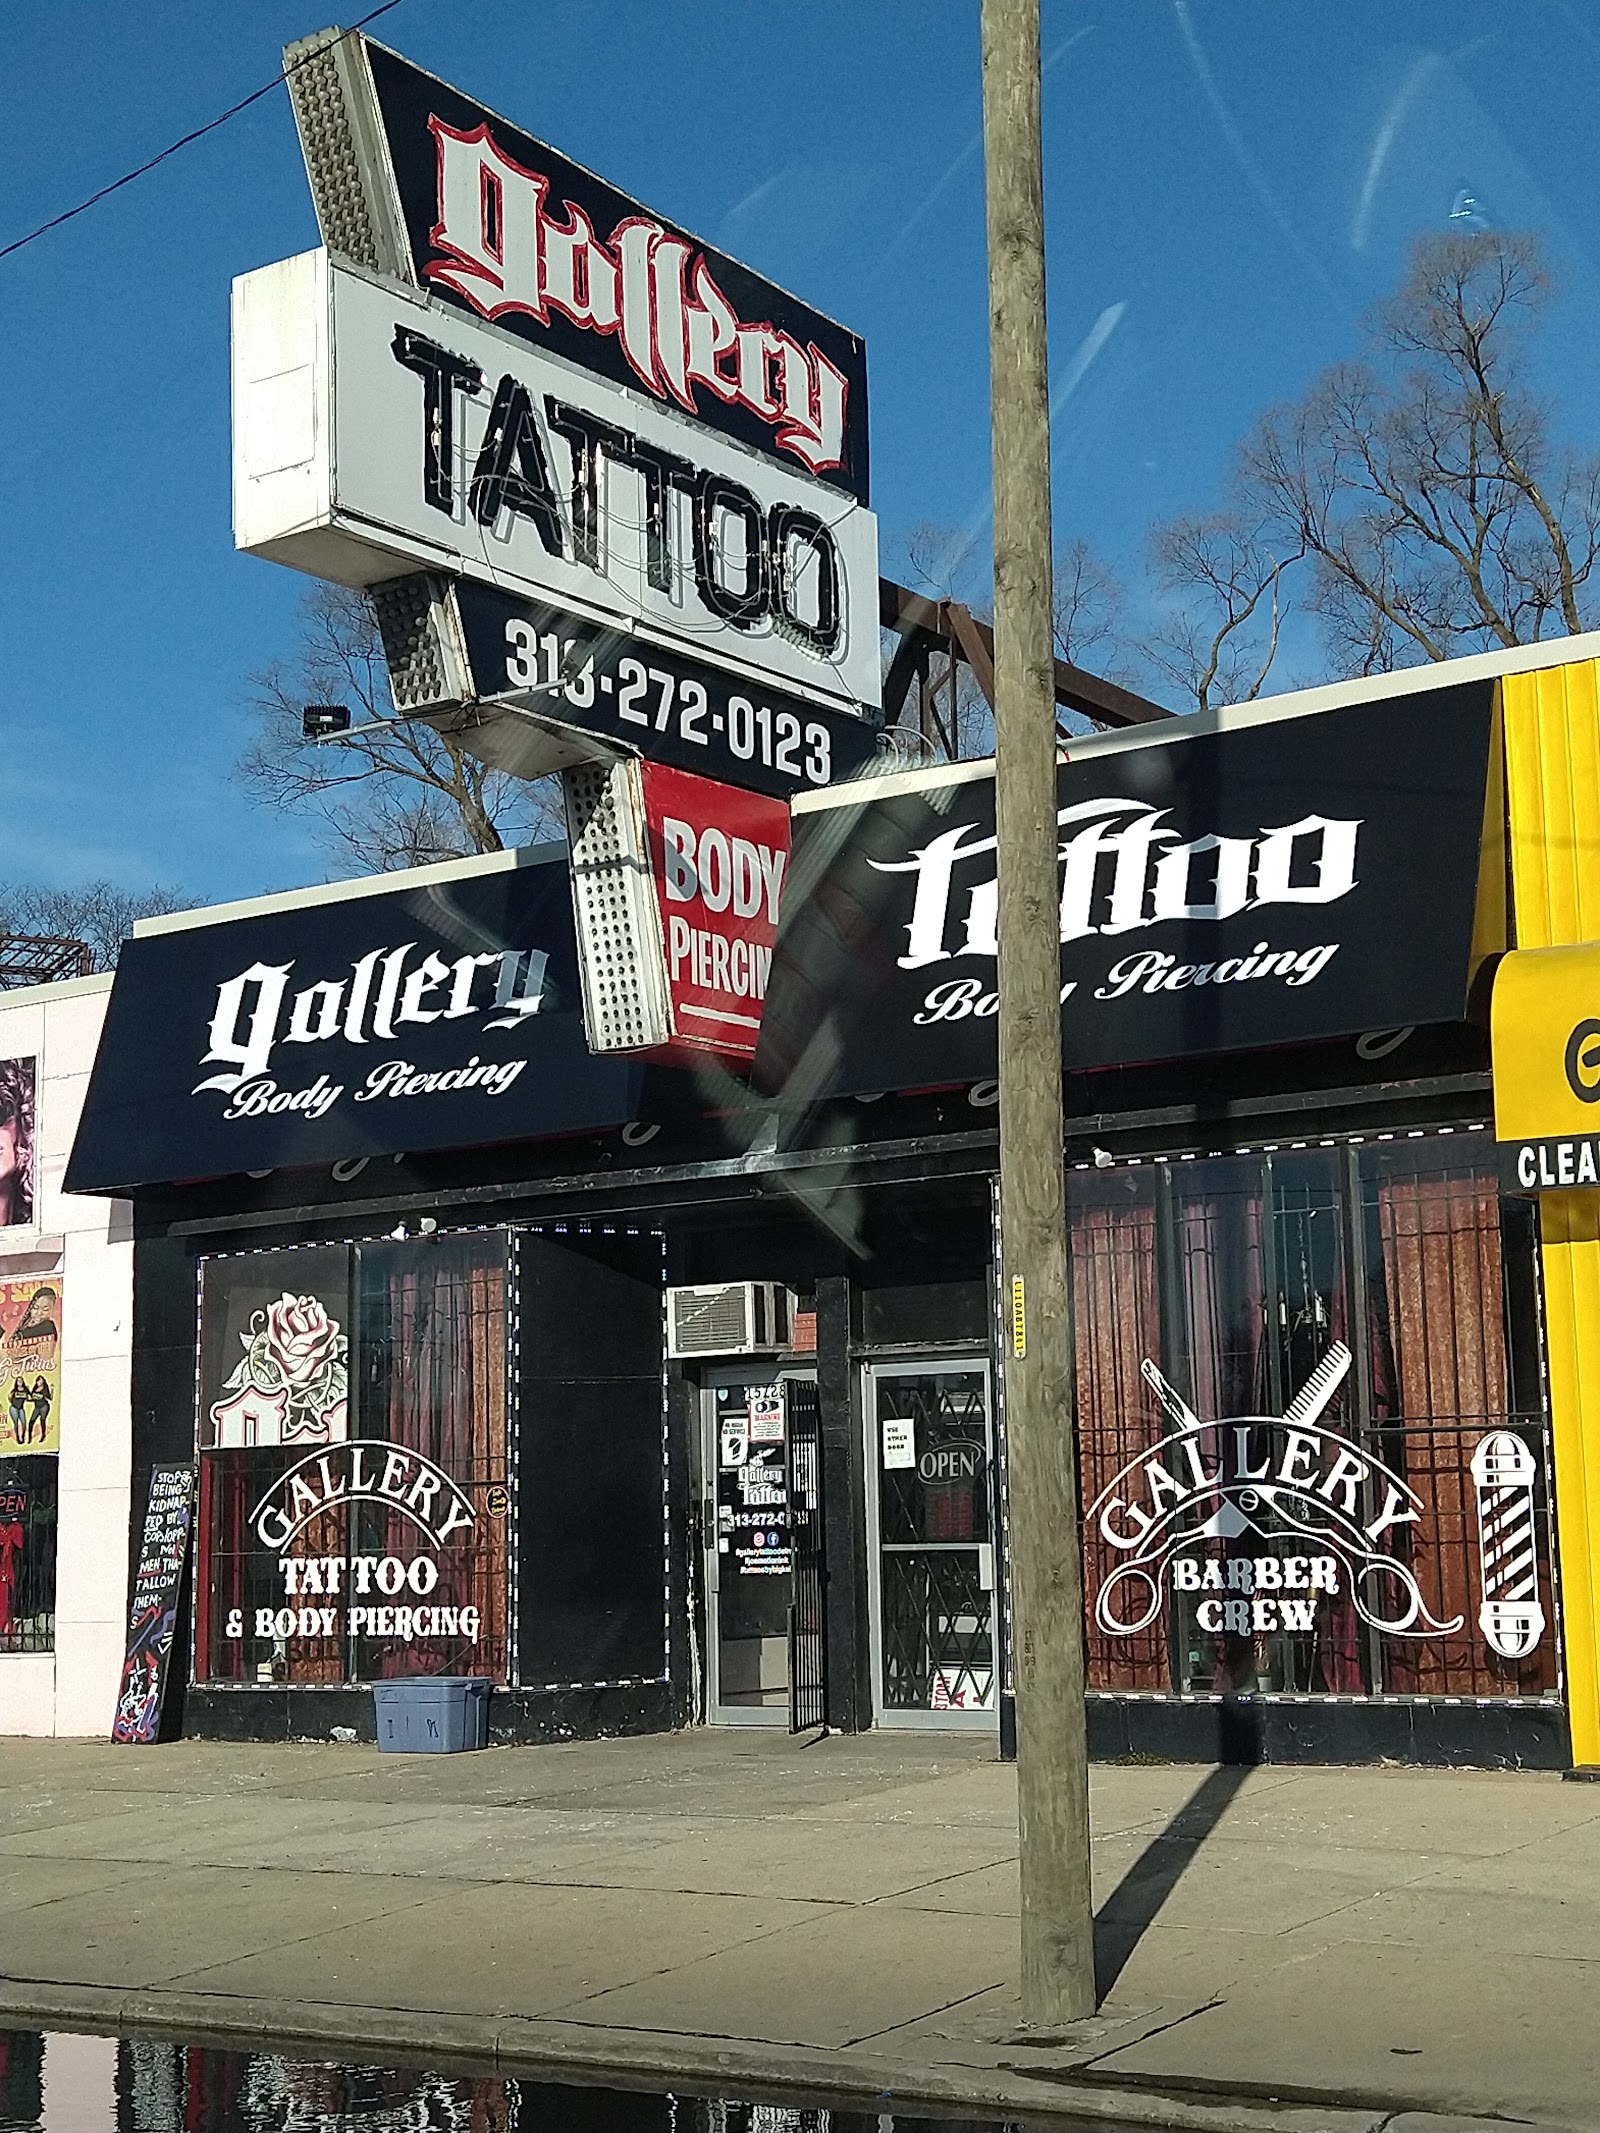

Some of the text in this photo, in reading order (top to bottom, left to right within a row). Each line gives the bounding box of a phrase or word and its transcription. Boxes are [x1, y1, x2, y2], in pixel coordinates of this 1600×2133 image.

[390, 323, 846, 657] TATTOO
[663, 816, 788, 926] BODY
[669, 915, 774, 1000] PIERCIN
[1094, 940, 1340, 1000] Piercing
[223, 1055, 528, 1120] Body Piercing
[1517, 1138, 1600, 1189] CLEA
[152, 1483, 182, 1497] BEING
[919, 1451, 975, 1479] OPEN
[1099, 1426, 1422, 1550] GALLERY
[257, 1447, 474, 1548] GALLERY
[278, 1556, 439, 1595] TATTOO
[1171, 1555, 1340, 1595] BARBER
[226, 1604, 481, 1644] & BODY PIERCING
[1195, 1598, 1318, 1637] CREW
